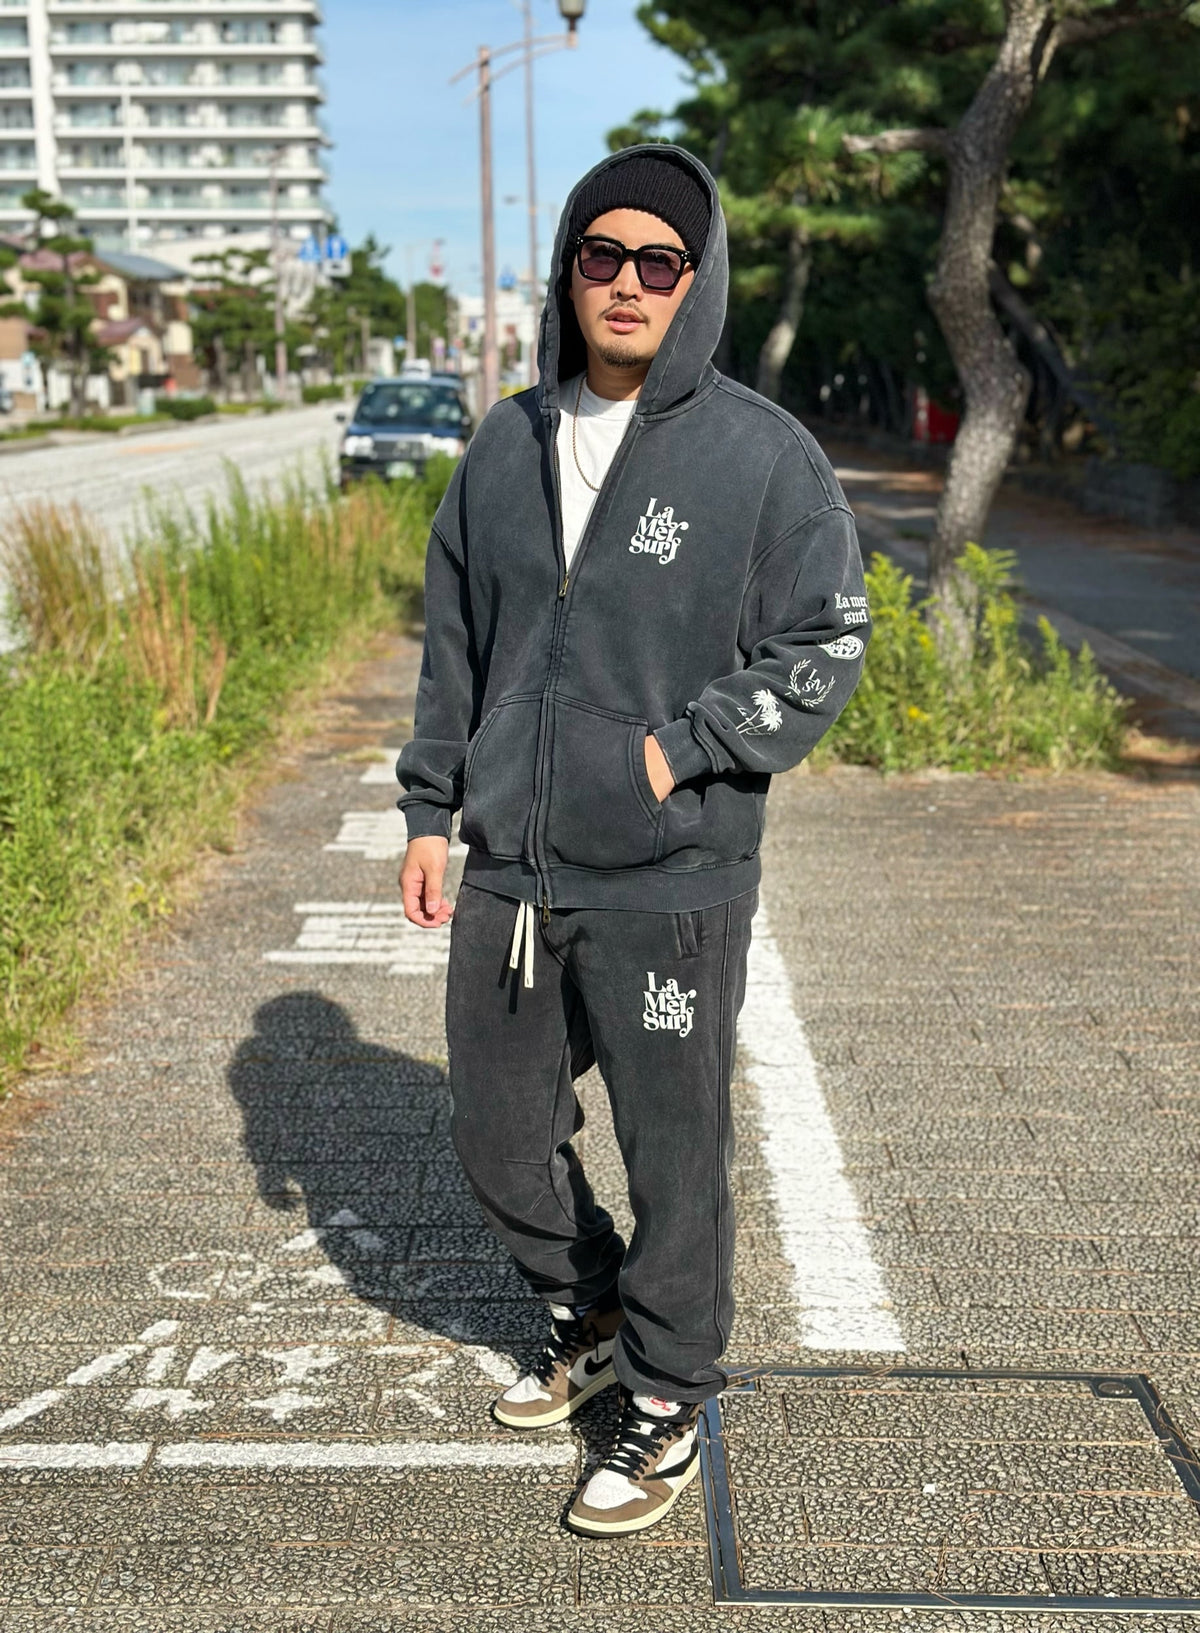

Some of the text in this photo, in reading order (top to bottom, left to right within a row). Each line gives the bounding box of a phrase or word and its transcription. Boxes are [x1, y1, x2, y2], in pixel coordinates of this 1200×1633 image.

[645, 497, 678, 529] La
[635, 515, 689, 543] Mer
[628, 534, 682, 565] Surf
[646, 971, 687, 1001] La
[643, 989, 697, 1015] Mer
[642, 1006, 695, 1038] Surf
